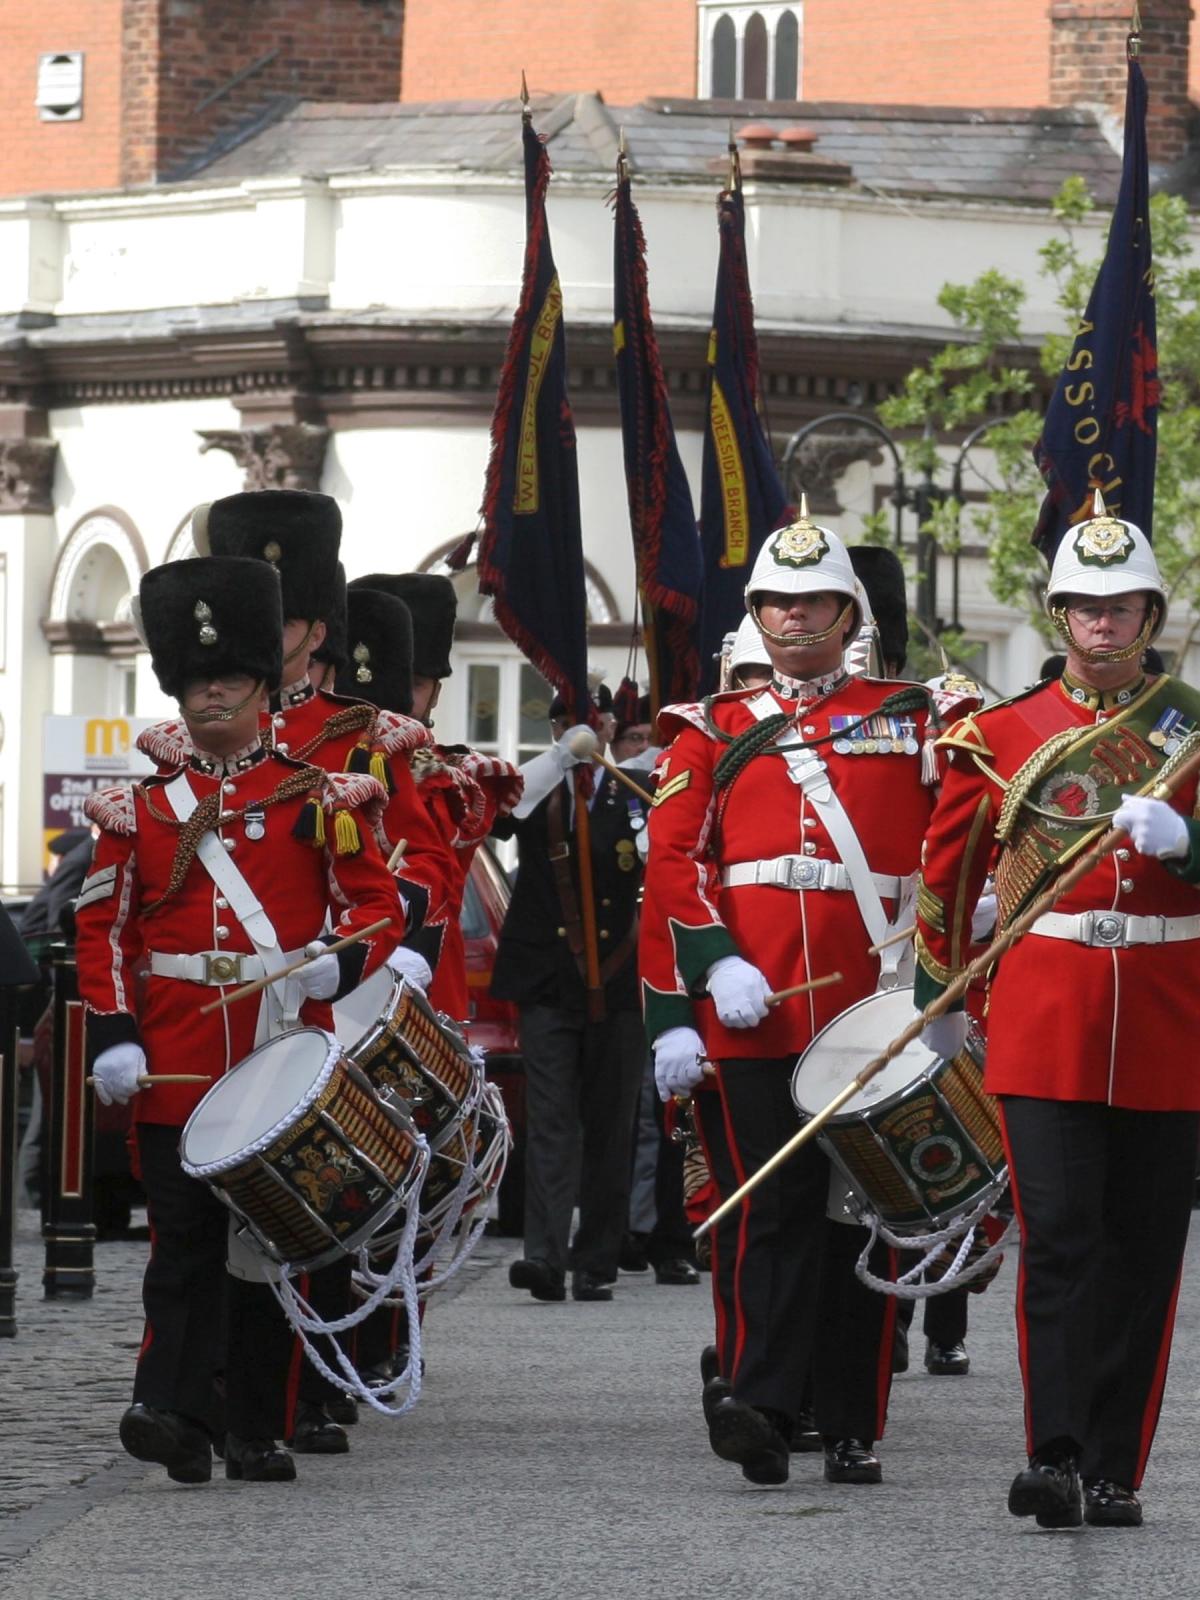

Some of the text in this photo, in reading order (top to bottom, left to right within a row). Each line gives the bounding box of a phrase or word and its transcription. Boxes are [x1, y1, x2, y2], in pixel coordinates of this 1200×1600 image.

[711, 414, 745, 549] DEESIDE BRANCH
[60, 778, 93, 794] 2nd
